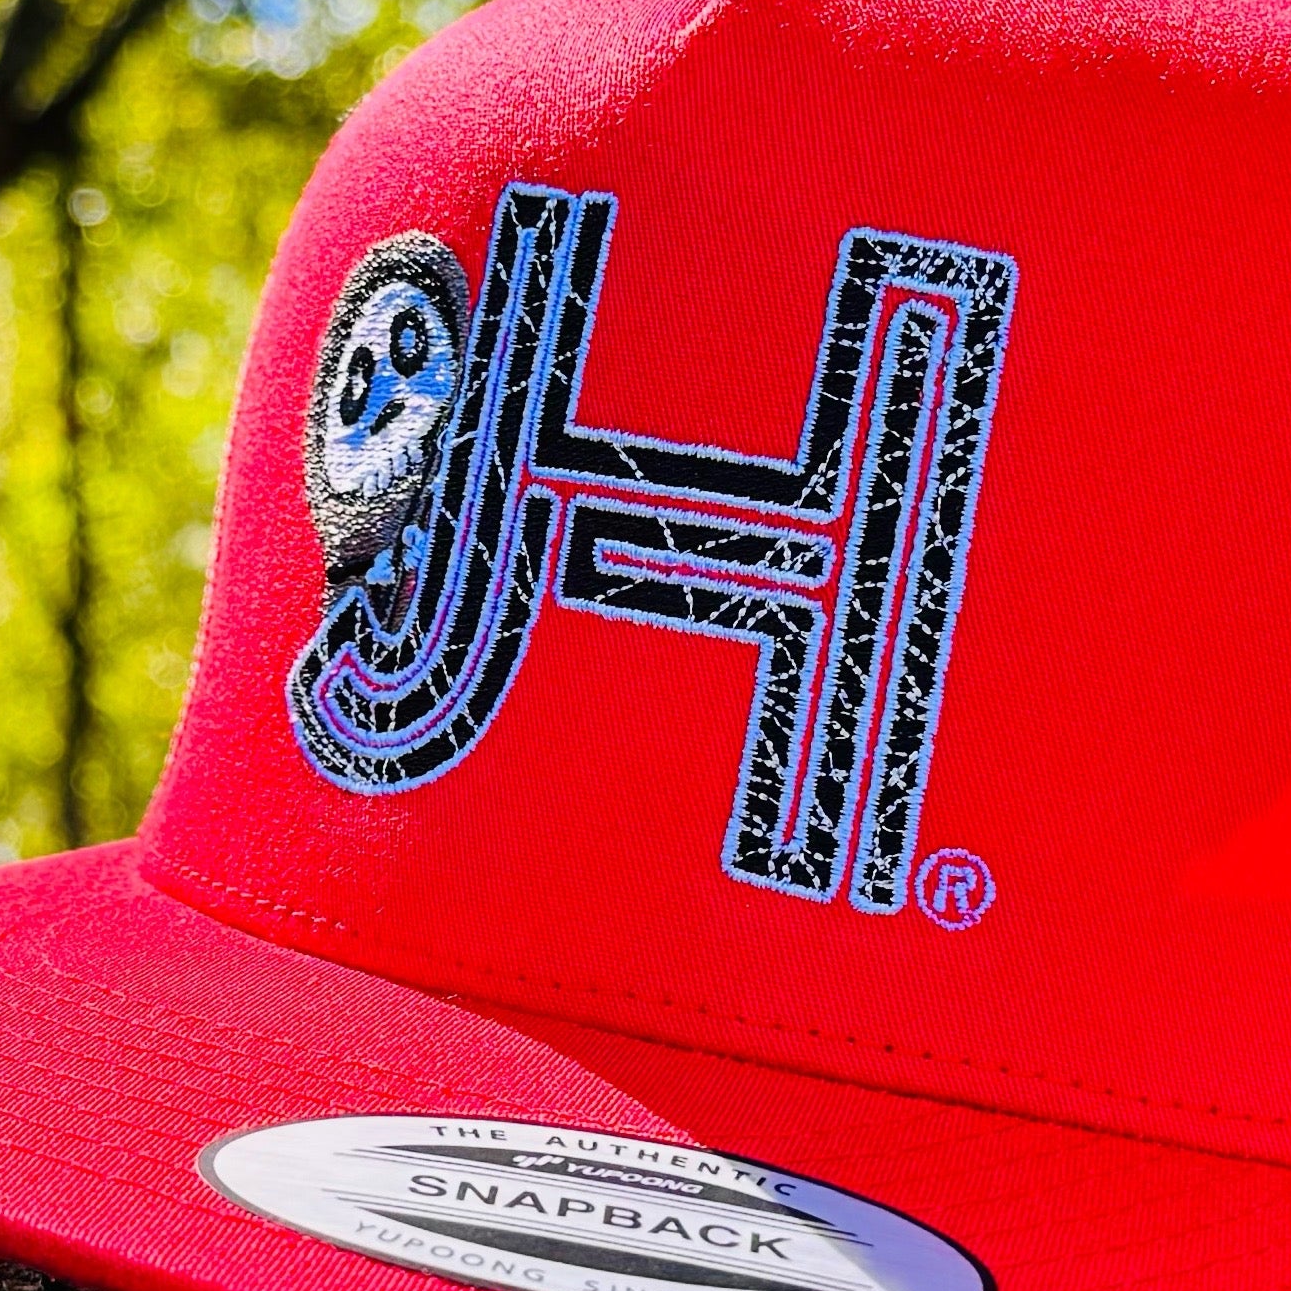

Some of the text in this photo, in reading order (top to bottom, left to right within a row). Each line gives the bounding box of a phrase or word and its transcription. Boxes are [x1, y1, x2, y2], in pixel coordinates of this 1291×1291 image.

[429, 1125, 797, 1197] THE AUTHENTIC
[566, 1162, 704, 1195] YUPOONG
[407, 1173, 793, 1261] SNAPBACK
[354, 1220, 546, 1283] YUPOONG
